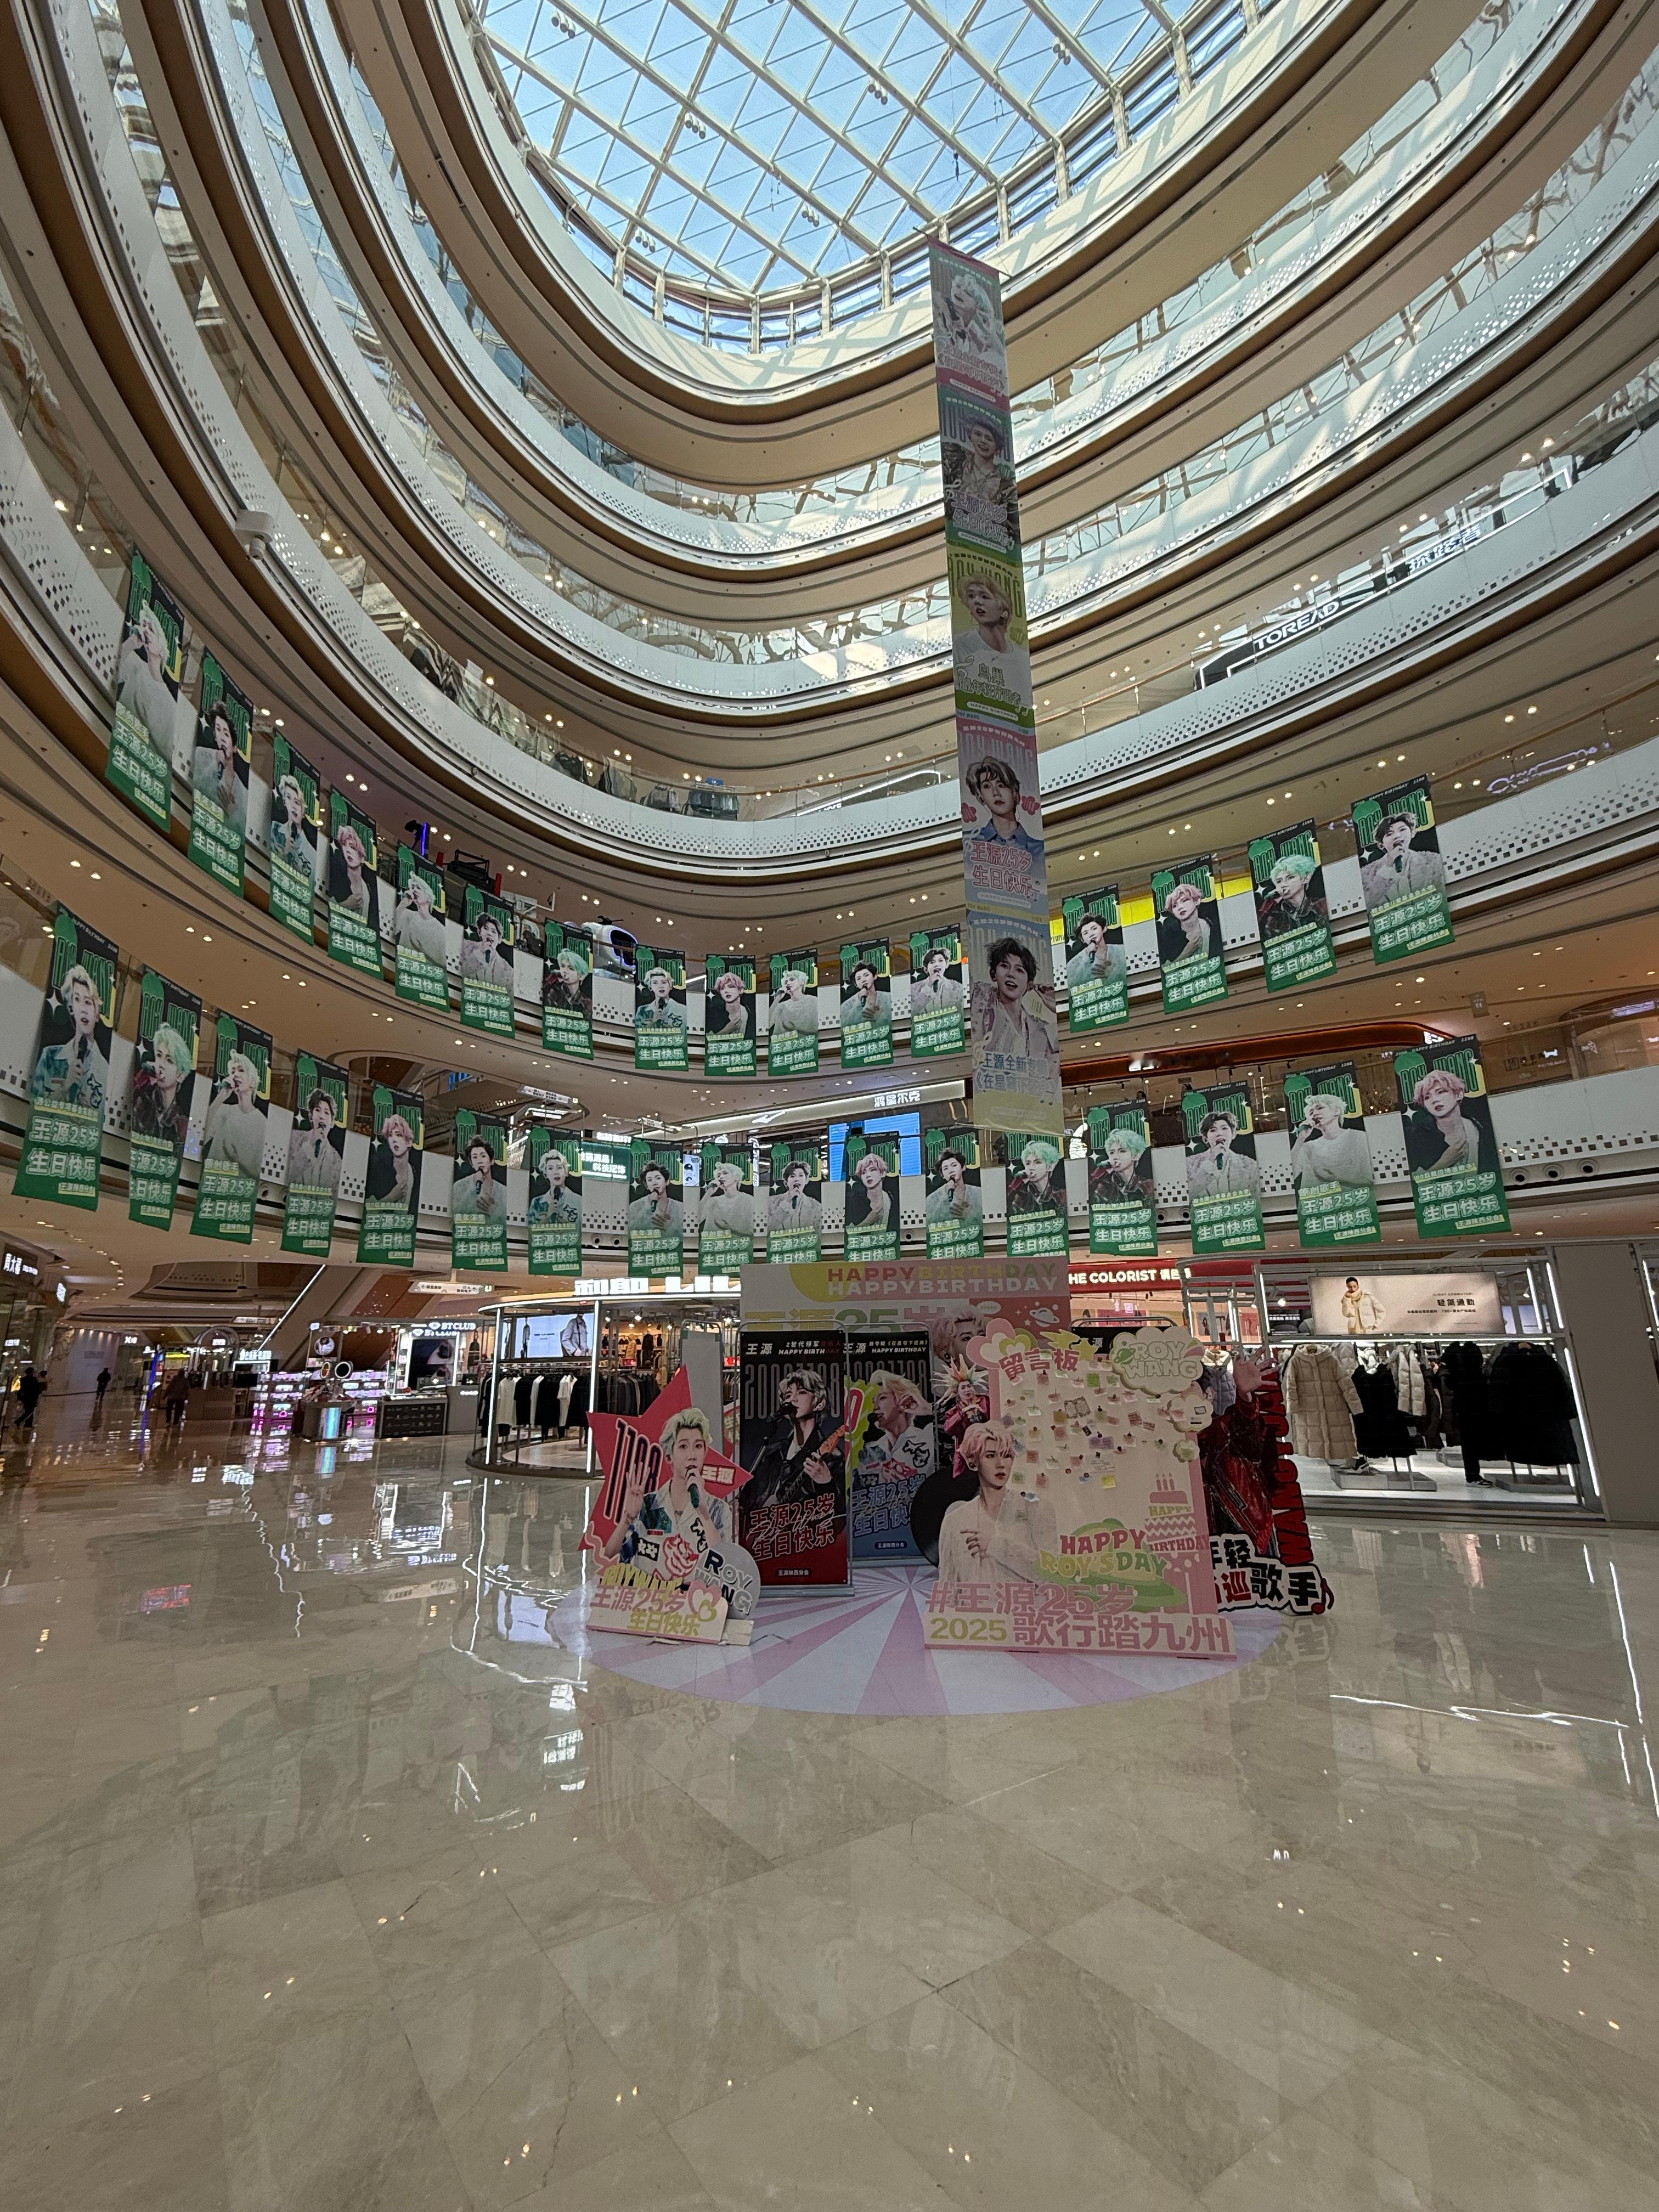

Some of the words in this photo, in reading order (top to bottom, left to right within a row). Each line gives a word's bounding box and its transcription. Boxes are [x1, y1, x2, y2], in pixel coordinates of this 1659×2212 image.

[1254, 601, 1339, 650] TOREAD
[970, 840, 1031, 872] 王源25岁
[973, 865, 1032, 897] 生日快乐
[1374, 893, 1442, 933] 王源25岁
[329, 915, 376, 944] 王源25岁
[1378, 912, 1446, 951] 生日快乐
[331, 933, 378, 962] 生日快乐
[1267, 928, 1327, 963] 王源25岁
[397, 956, 444, 979] 王源25岁
[1165, 957, 1221, 985] 王源25岁
[1271, 946, 1329, 980] 生日快乐
[399, 973, 444, 996] 生日快乐
[1071, 981, 1124, 1008] 王源25岁
[1168, 973, 1222, 1003] 生日快乐
[464, 988, 510, 1007] 王源25岁
[465, 1003, 510, 1023] 生日快乐
[1074, 997, 1125, 1023] 生日快乐
[545, 1014, 589, 1031] 王源25岁
[914, 1014, 961, 1035] 王源25岁
[546, 1029, 589, 1047] 生日快乐
[639, 1035, 684, 1048] 王源25岁
[771, 1035, 815, 1053] 王源25岁
[844, 1025, 889, 1046] 王源25岁
[915, 1028, 961, 1048] 生日快乐
[639, 1048, 684, 1060] 生日快乐
[708, 1040, 753, 1053] 王源25岁
[845, 1040, 889, 1059] 生日快乐
[708, 1053, 753, 1068] 生日快乐
[772, 1049, 815, 1068] 生日快乐
[983, 1053, 1048, 1076] 王源全新专
[874, 1090, 921, 1107] 鸿星尔克
[30, 1116, 100, 1151] 王源25岁
[26, 1148, 97, 1181] 生日快乐
[201, 1174, 256, 1198] 王源25岁
[1418, 1172, 1496, 1203] 王源25岁
[199, 1198, 251, 1221] 生日快乐
[288, 1198, 333, 1216] 王源25岁
[1194, 1200, 1256, 1223] 王源25岁
[1302, 1187, 1369, 1216] 王源25岁
[1423, 1194, 1500, 1224] 生日快乐
[286, 1219, 329, 1237] 生日快乐
[364, 1214, 414, 1231] 王源25岁
[1010, 1217, 1064, 1238] 王源25岁
[1093, 1209, 1152, 1227] 王源25岁
[1304, 1207, 1372, 1234] 生日快乐
[455, 1224, 504, 1239] 王源25岁
[930, 1225, 980, 1245] 王源25岁
[1095, 1226, 1152, 1242] 生日快乐
[1197, 1217, 1257, 1242] 生日快乐
[364, 1233, 412, 1250] 生日快乐
[456, 1242, 503, 1257] 生日快乐
[531, 1233, 578, 1248] 王源25岁
[630, 1237, 680, 1252] 王源25岁
[701, 1237, 750, 1252] 王源25岁
[770, 1234, 818, 1252] 王源25岁
[847, 1231, 896, 1249] 王源25岁
[1012, 1235, 1064, 1254] 生日快乐
[533, 1249, 578, 1263] 生日快乐
[632, 1252, 679, 1267] 生日快乐
[702, 1252, 749, 1267] 生日快乐
[770, 1250, 817, 1263] 生日快乐
[848, 1247, 896, 1262] 生日快乐
[931, 1242, 979, 1260] 生日快乐
[828, 1266, 915, 1282] HAPPY
[918, 1262, 1057, 1279] BIRTHDAY
[1069, 1272, 1087, 1284] HE
[1089, 1269, 1157, 1283] COLORIST
[746, 1343, 772, 1355] 王源
[843, 1342, 867, 1353] 王源
[1129, 1341, 1186, 1359] ROY
[998, 1348, 1081, 1382] 留言板
[1124, 1359, 1199, 1379] WANG
[702, 1465, 734, 1485] 王源
[850, 1474, 926, 1509] 王源25岁
[750, 1493, 835, 1533] 王源25岁
[854, 1502, 912, 1537] 生日快
[1149, 1505, 1192, 1516] HAPPY
[752, 1522, 834, 1561] 生日快乐
[1060, 1528, 1148, 1555] HAPPY
[704, 1549, 753, 1590] ROY
[1214, 1563, 1319, 1606] 巡歌手
[590, 1585, 688, 1613] 王源25岁
[925, 1580, 1138, 1616] #王源25岁
[627, 1610, 701, 1636] 生日快乐
[930, 1617, 1009, 1641] 2025
[1013, 1613, 1230, 1652] 歌行踏九州
